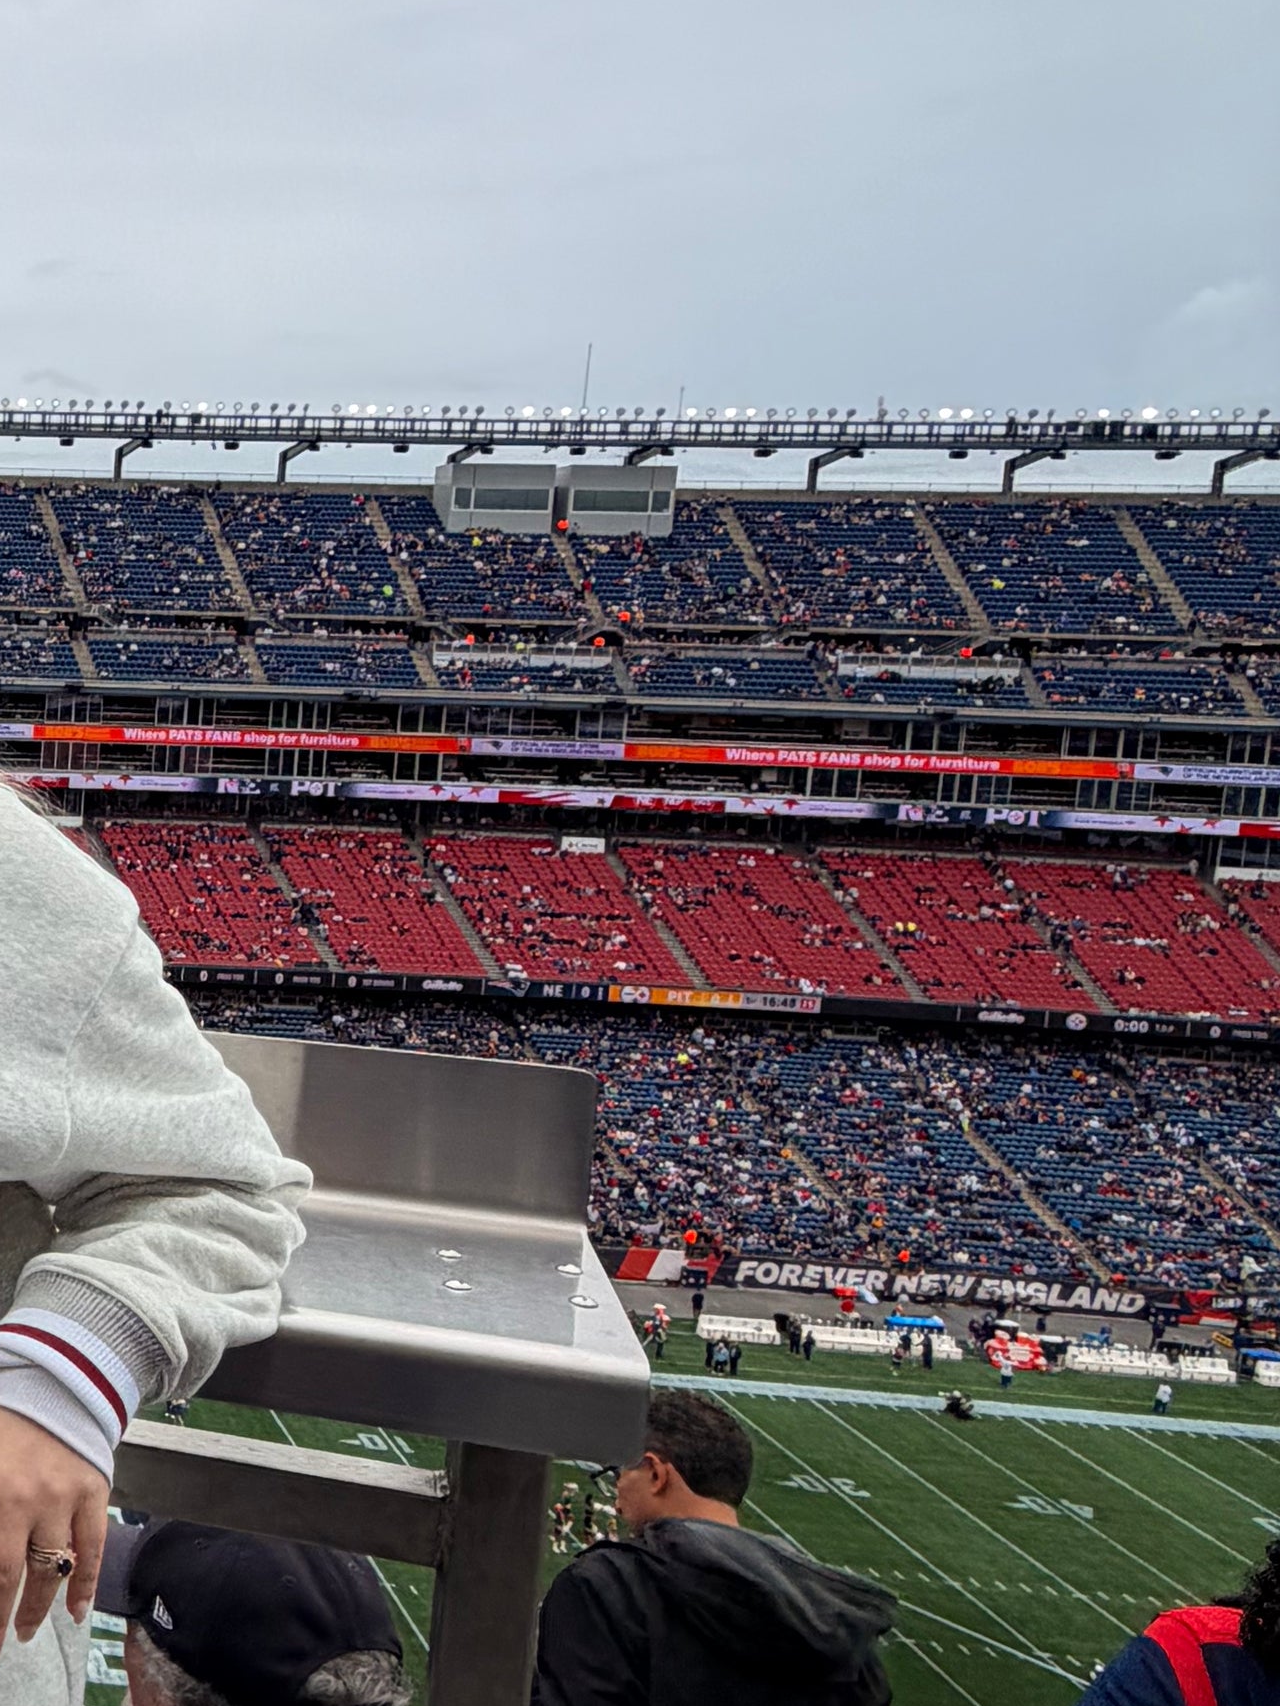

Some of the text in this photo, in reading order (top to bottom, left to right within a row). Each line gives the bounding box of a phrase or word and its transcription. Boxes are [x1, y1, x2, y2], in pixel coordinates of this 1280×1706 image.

[122, 727, 166, 740] Where
[169, 728, 203, 741] PATS
[206, 730, 241, 743] FANS
[244, 731, 276, 745] shop
[278, 732, 299, 744] for
[300, 733, 359, 747] furniture
[726, 748, 775, 761] Where
[778, 750, 817, 763] PATS
[820, 752, 860, 765] FANS
[864, 753, 901, 769] shop
[904, 755, 927, 768] for
[930, 756, 1000, 771] furniture
[422, 978, 464, 992] Gillette
[543, 984, 564, 998] NE
[580, 986, 590, 999] 0
[1113, 1019, 1149, 1034] 0:00
[735, 1259, 1146, 1315] FOREVER NEW ENGLAND
